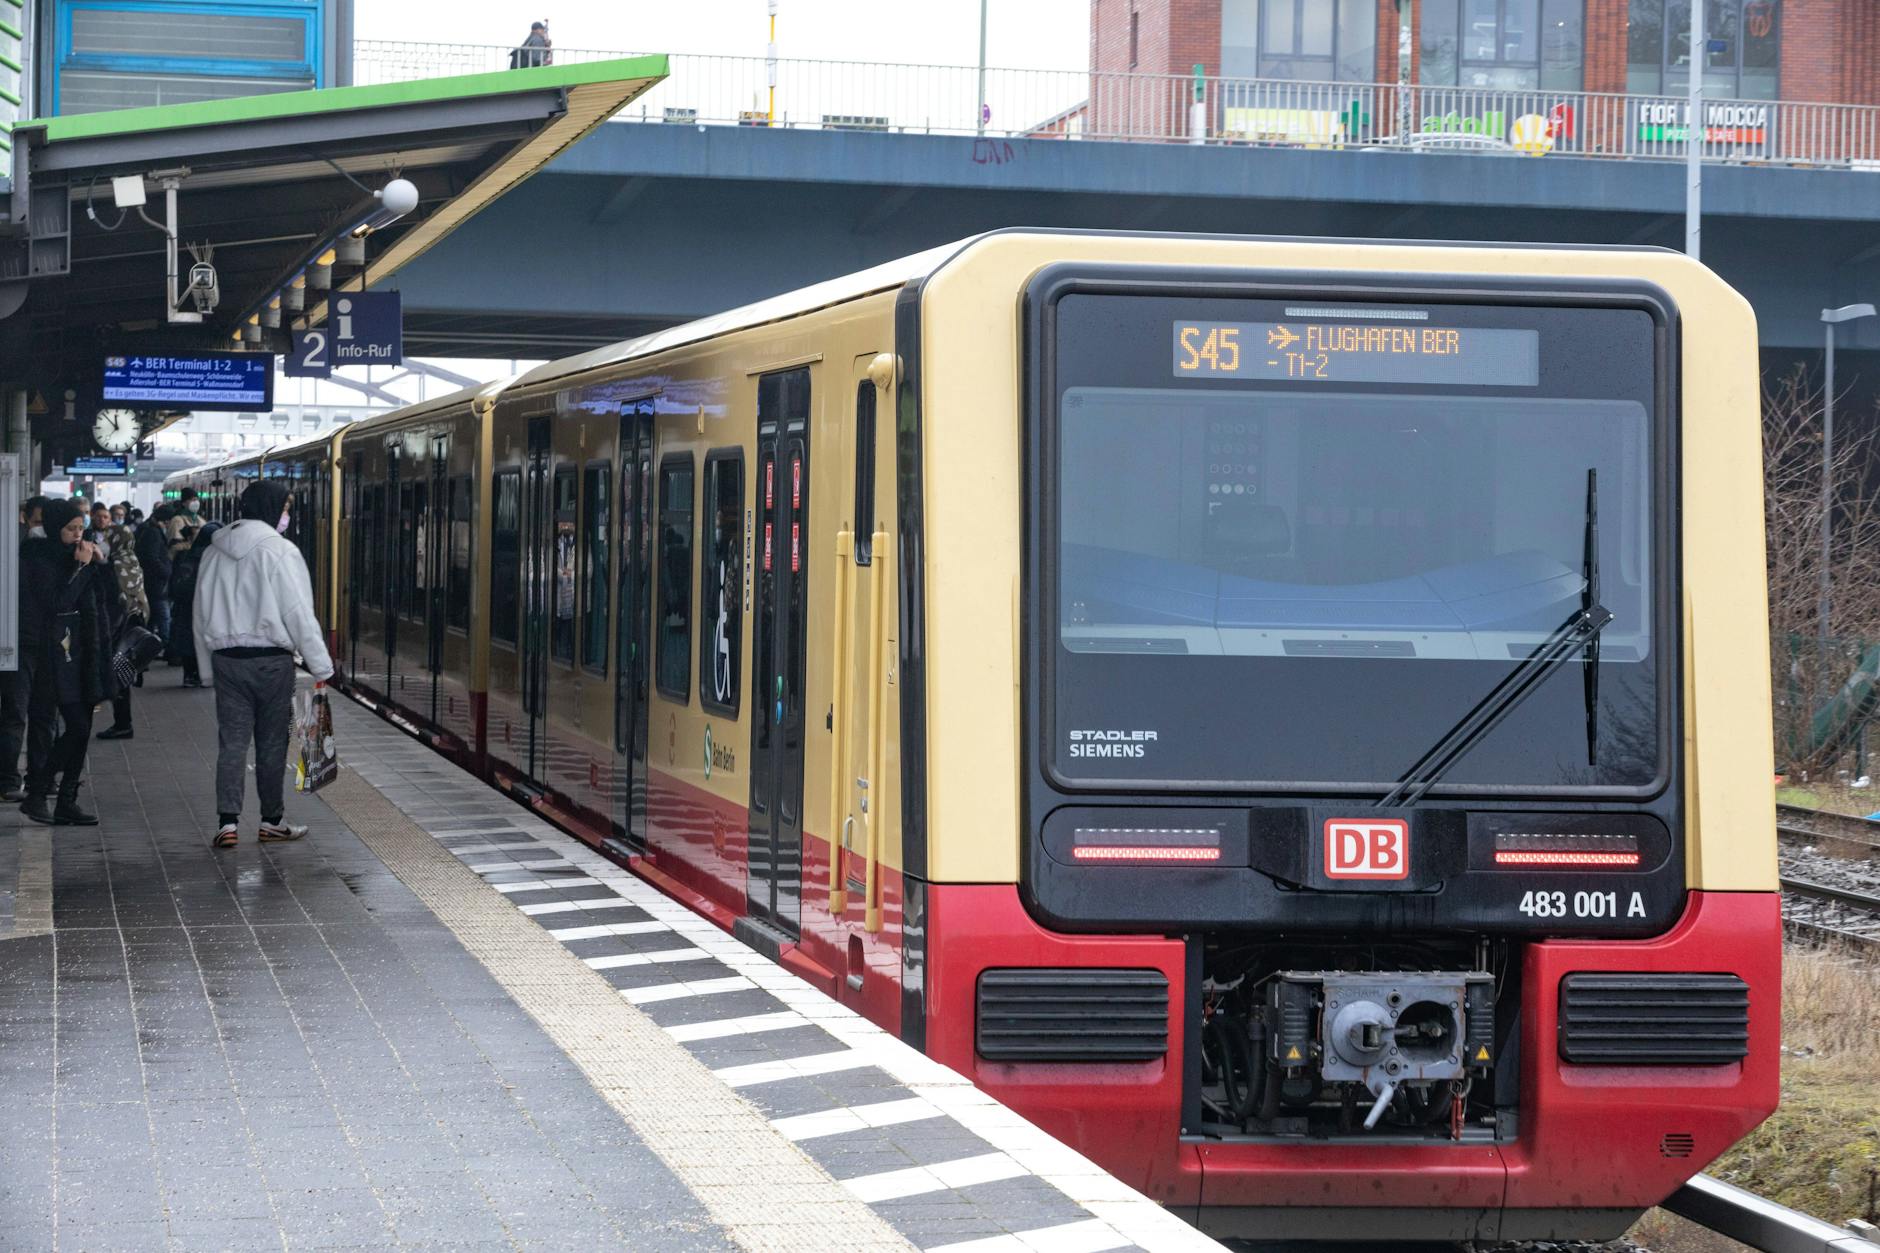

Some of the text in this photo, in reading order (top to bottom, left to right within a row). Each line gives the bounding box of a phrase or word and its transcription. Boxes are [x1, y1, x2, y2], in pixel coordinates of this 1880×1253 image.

[303, 332, 325, 367] 2
[337, 344, 392, 357] Info-Ruf
[1179, 326, 1460, 370] S45 FLUGHAFEN BER
[106, 357, 125, 367] S45
[146, 357, 166, 369] BER
[168, 357, 211, 370] Terminal
[214, 359, 231, 371] 1-2
[246, 360, 252, 371] 1
[1284, 353, 1329, 377] T1-2
[143, 443, 153, 456] 2
[1069, 730, 1158, 741] STADLER
[1069, 743, 1145, 757] SIEMENS
[1335, 829, 1399, 869] DB
[1519, 891, 1646, 917] 483 001 A
